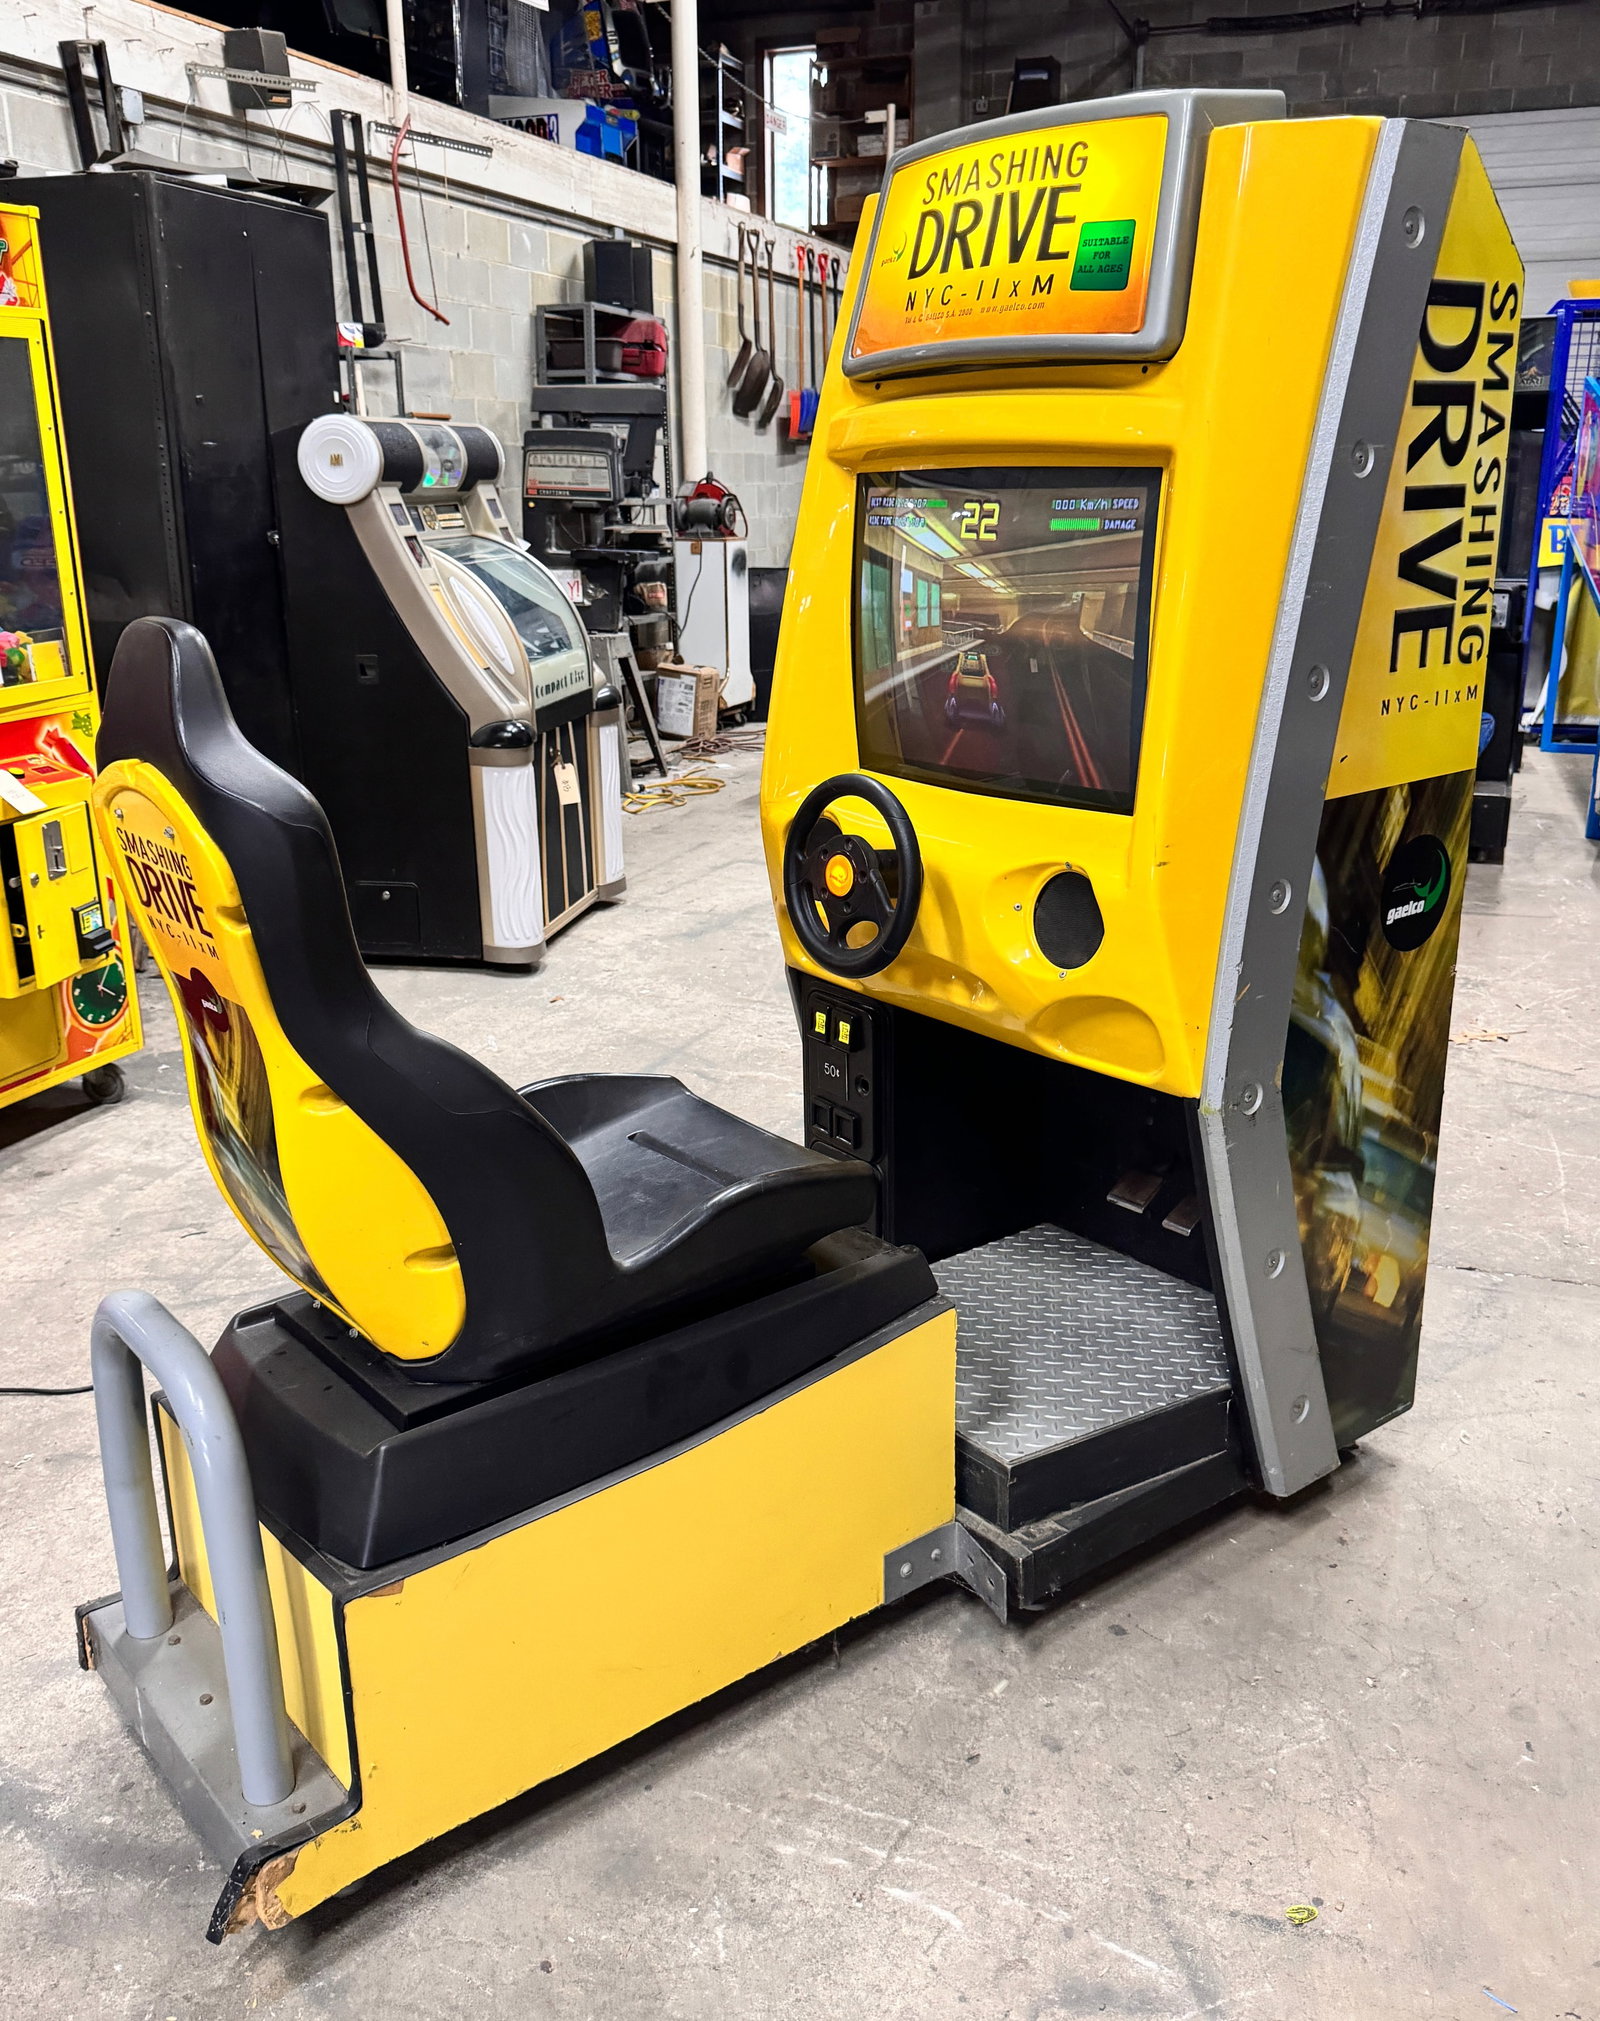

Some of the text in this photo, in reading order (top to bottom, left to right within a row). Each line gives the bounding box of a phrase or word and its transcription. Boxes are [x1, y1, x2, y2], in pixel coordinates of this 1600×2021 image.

[922, 141, 1089, 205] SMASHING
[907, 183, 1081, 281] DRIVE
[1082, 236, 1129, 248] SUITABLE
[1077, 263, 1123, 273] ALL AGES
[1092, 250, 1111, 260] FOR
[980, 301, 1045, 314] www.gaelco.com
[1389, 279, 1485, 673] DRIVE
[1457, 280, 1519, 666] SMASHING
[1055, 498, 1139, 511] 000 Km/h SPEED
[960, 502, 999, 540] 22
[1104, 519, 1137, 530] DAMAGE
[535, 669, 585, 699] Compact Disc
[116, 827, 193, 881] SMASHING
[125, 855, 214, 939] DRIVE
[1386, 900, 1425, 925] gaelco
